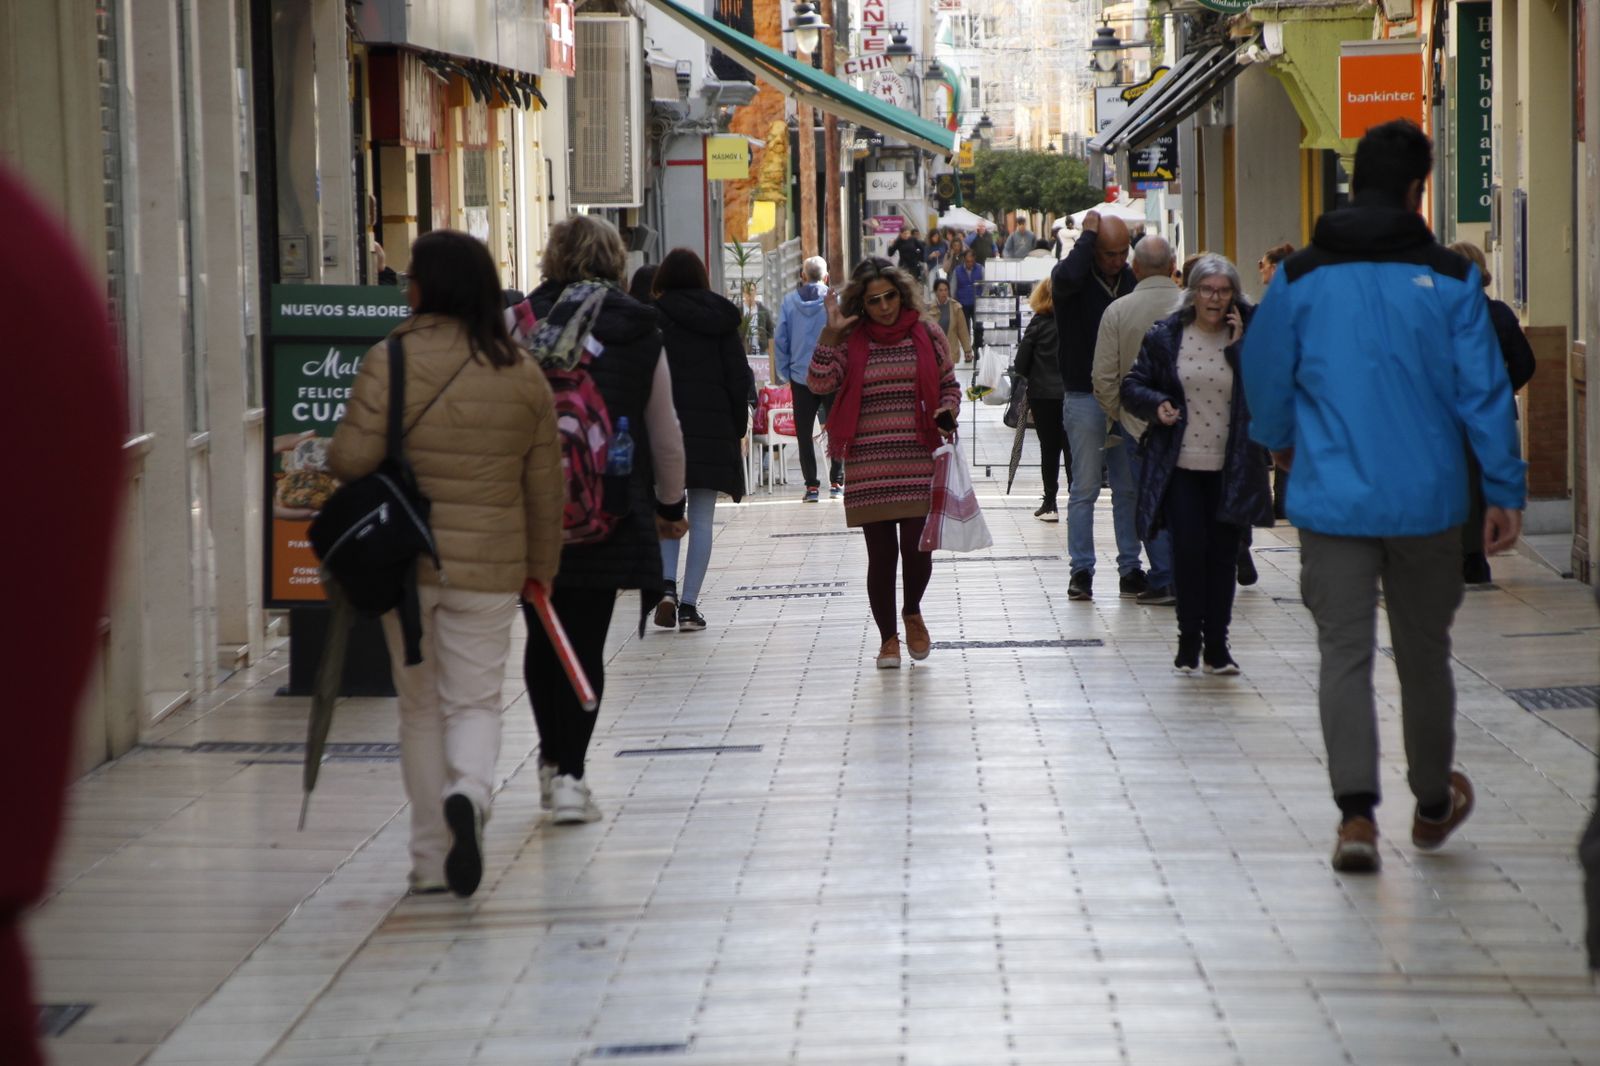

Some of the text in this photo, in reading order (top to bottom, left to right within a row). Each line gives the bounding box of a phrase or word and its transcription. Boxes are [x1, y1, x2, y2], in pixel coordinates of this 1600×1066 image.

[844, 54, 913, 75] CHIN
[1477, 16, 1493, 207] Herbolario
[281, 304, 344, 316] NUEVOS
[302, 347, 364, 379] Mal
